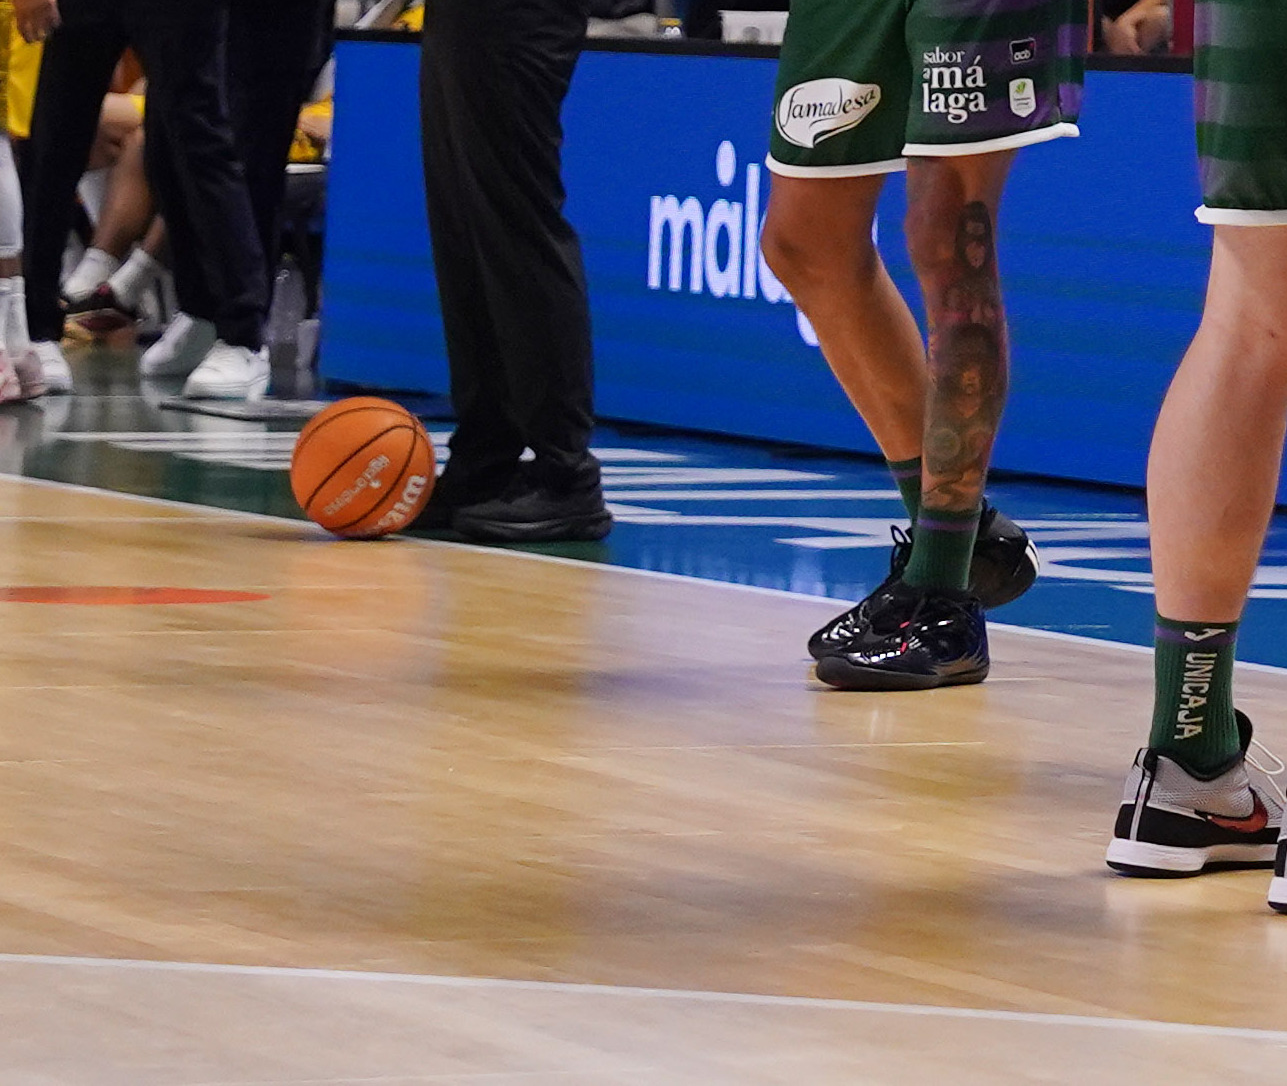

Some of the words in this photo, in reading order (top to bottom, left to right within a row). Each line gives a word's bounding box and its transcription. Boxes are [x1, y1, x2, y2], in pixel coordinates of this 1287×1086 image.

[923, 46, 966, 64] sabor
[785, 84, 878, 127] famadesa
[922, 82, 988, 124] laga
[1174, 652, 1218, 741] UNICAJA
